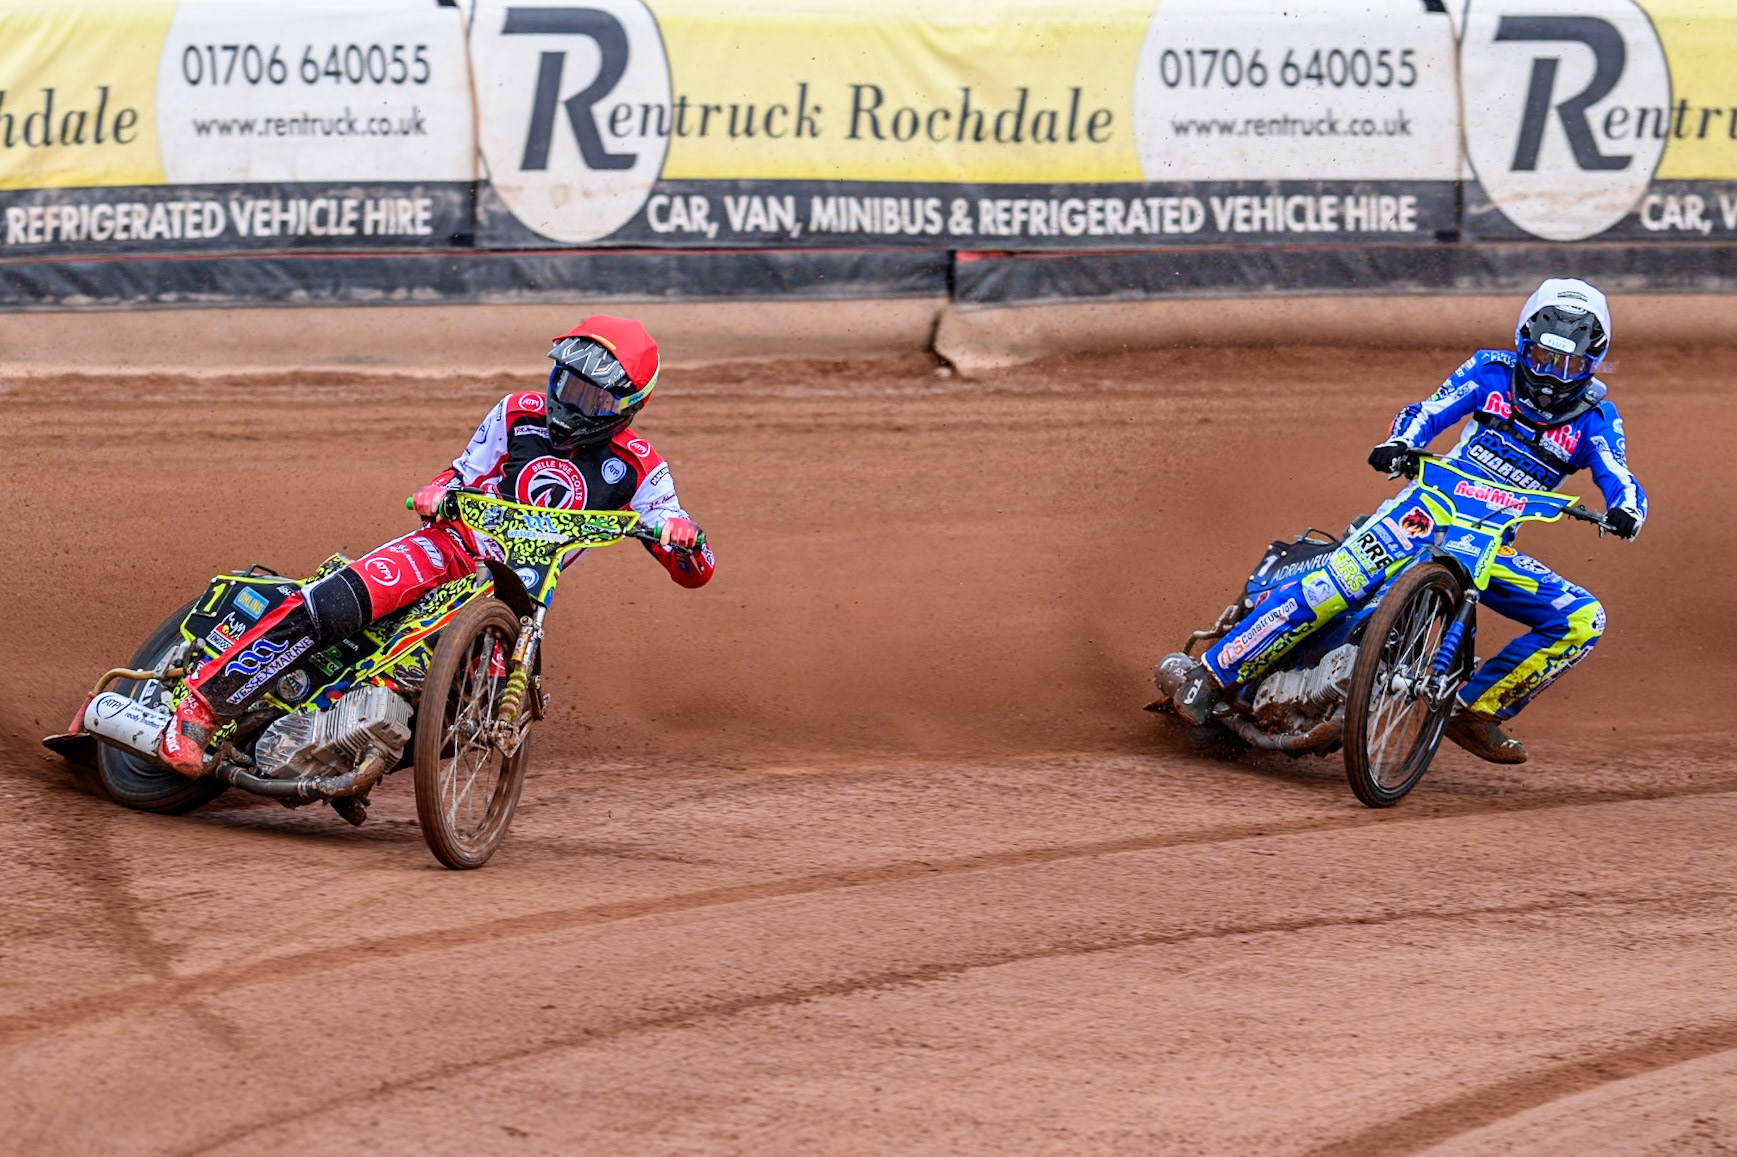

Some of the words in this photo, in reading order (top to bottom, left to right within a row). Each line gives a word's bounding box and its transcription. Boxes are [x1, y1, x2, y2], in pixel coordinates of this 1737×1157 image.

[183, 44, 288, 86] 01706
[300, 43, 431, 85] 640055
[1160, 48, 1268, 88] 01706
[1280, 48, 1418, 88] 640055
[193, 106, 427, 138] www.rentruck.co.uk
[844, 83, 1114, 144] Rochdale
[1171, 108, 1411, 138] www.rentruck.co.uk
[5, 201, 227, 245] REFRIGERATED
[227, 199, 358, 238] VEHICLE
[363, 198, 433, 236] HIRE
[647, 194, 718, 239] CAR,
[724, 195, 801, 239] VAN,
[809, 196, 944, 237] MINIBUS
[947, 197, 973, 236] &
[979, 196, 1206, 237] REFRIGERATED
[1208, 195, 1338, 234] VEHICLE
[1343, 195, 1418, 233] HIRE
[1640, 193, 1713, 236] CAR,
[1480, 433, 1559, 485] OXFORD
[531, 460, 556, 473] BELLE
[557, 462, 573, 475] VUE
[571, 474, 583, 501] COLTS
[1454, 481, 1492, 502] Real
[373, 561, 393, 580] ATPI
[1257, 554, 1279, 578] 1
[1270, 552, 1333, 584] ADRIANFLU
[203, 583, 227, 612] 1
[101, 698, 124, 711] ATPI
